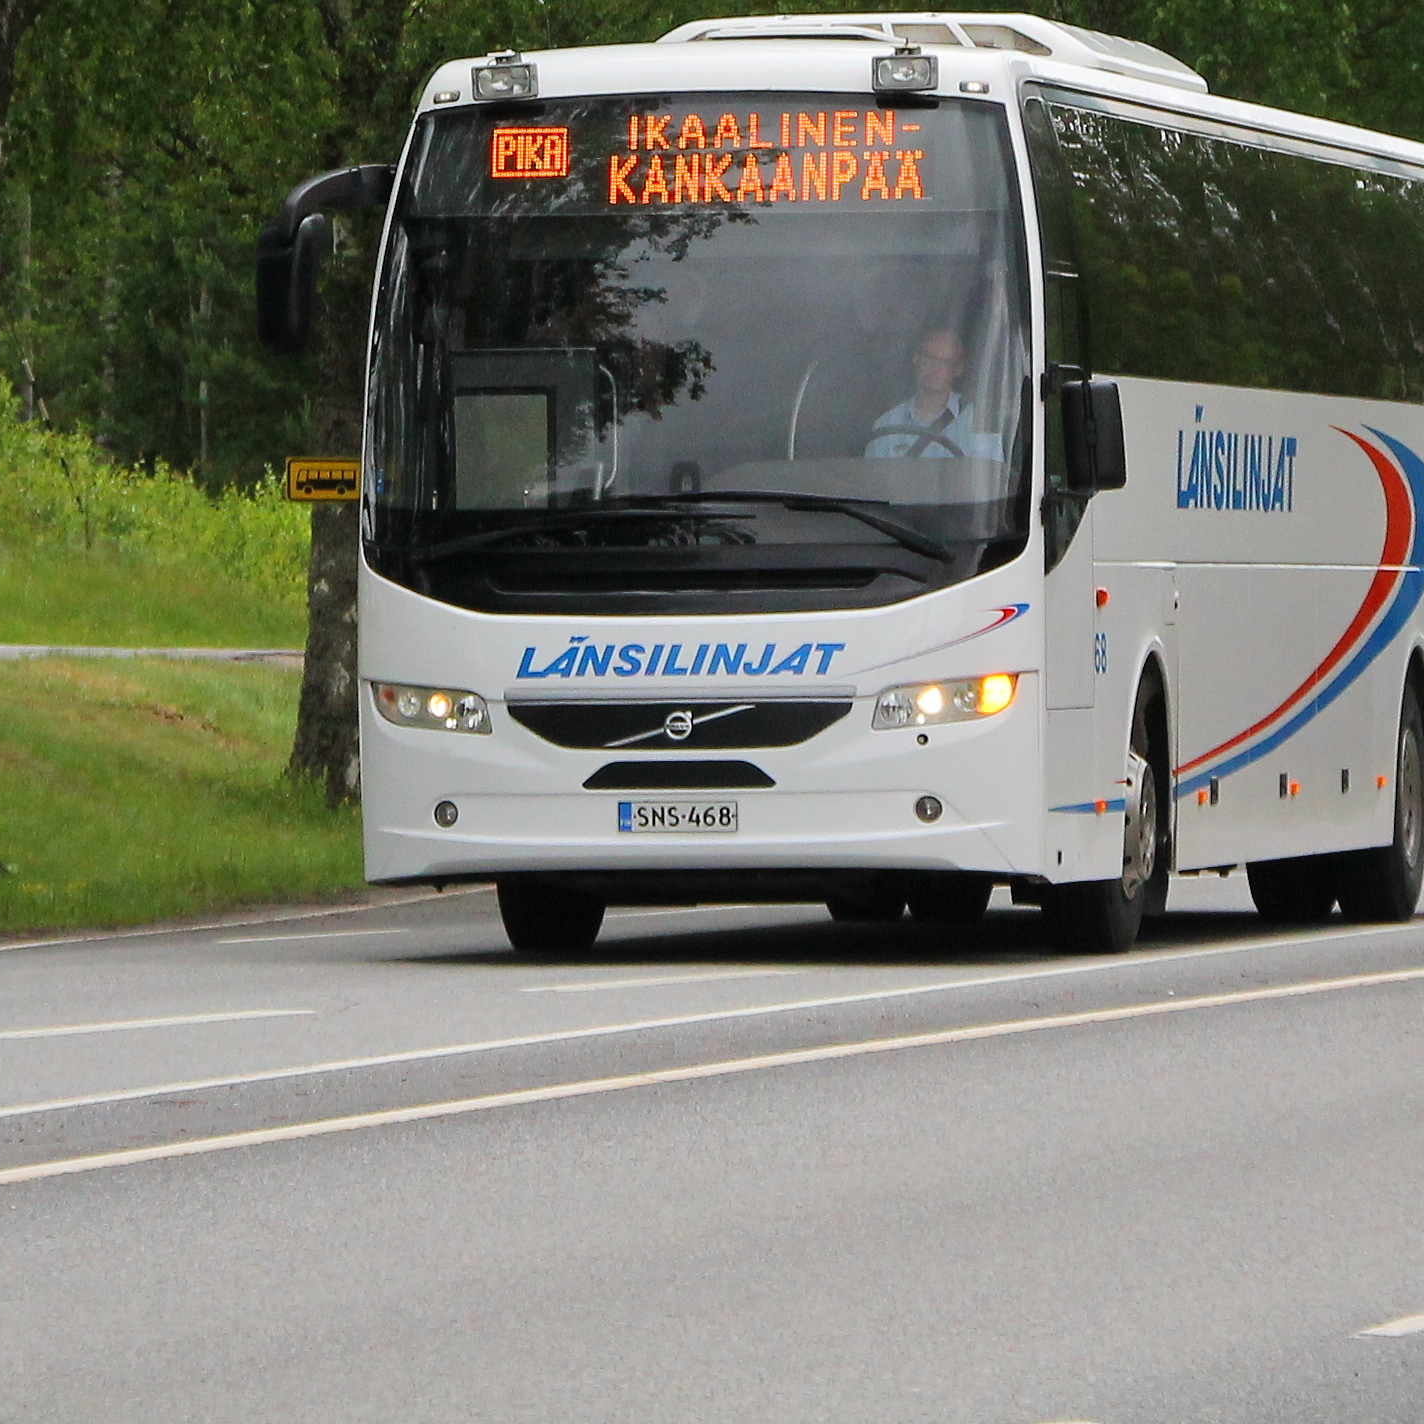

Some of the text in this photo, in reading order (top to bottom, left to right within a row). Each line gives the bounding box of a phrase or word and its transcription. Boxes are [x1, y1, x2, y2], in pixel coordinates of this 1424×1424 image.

[497, 132, 563, 171] PIKA
[609, 150, 924, 205] KANKAANPÄÄ
[1177, 404, 1297, 513] LÄNSILINJAT
[515, 636, 845, 678] LÄNSILINJAT
[1094, 632, 1107, 674] 68
[636, 806, 732, 827] SNS-468
